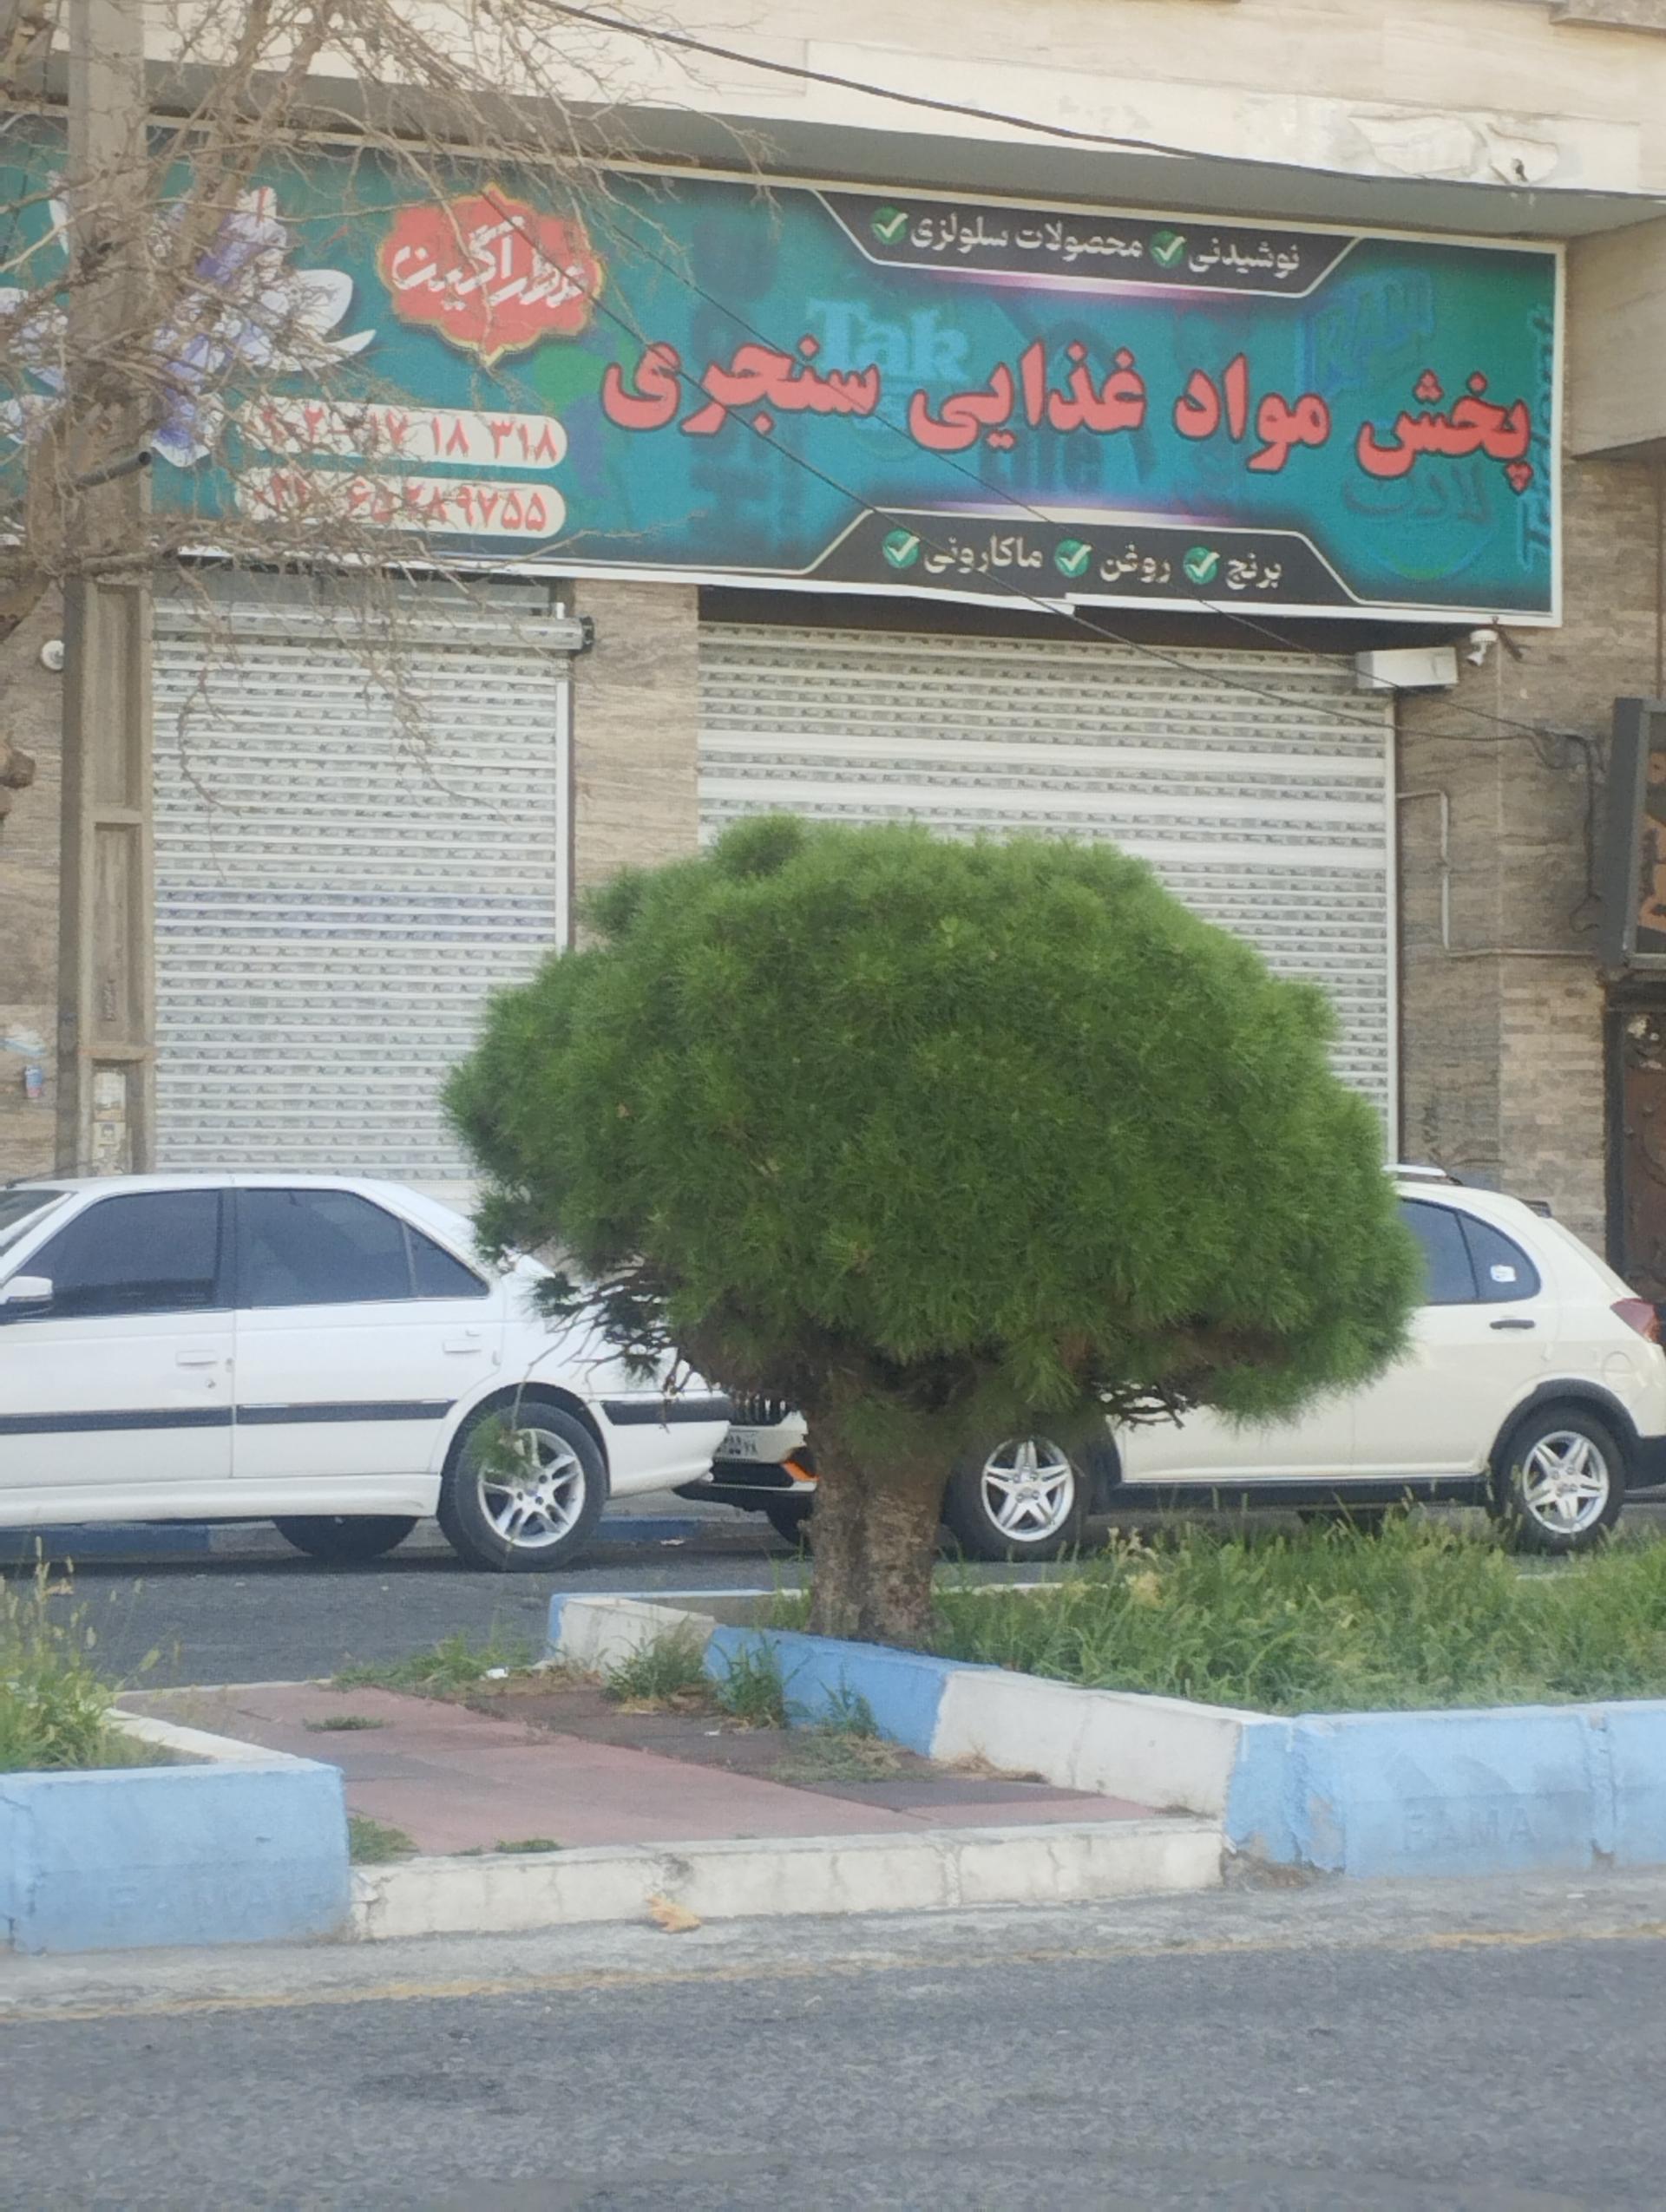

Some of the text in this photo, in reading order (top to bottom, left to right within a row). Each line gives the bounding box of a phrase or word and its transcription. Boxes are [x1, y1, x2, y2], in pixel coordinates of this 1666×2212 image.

[908, 212, 1301, 278] نوشیدنی محصولات سلولزی
[601, 334, 882, 436] سنجری
[908, 334, 1147, 451] غذایی
[1173, 351, 1331, 474] مواد
[1355, 369, 1533, 494] پخش
[489, 419, 559, 463] ۳۱۸
[922, 533, 1282, 590] برنج روغن ماکارونی
